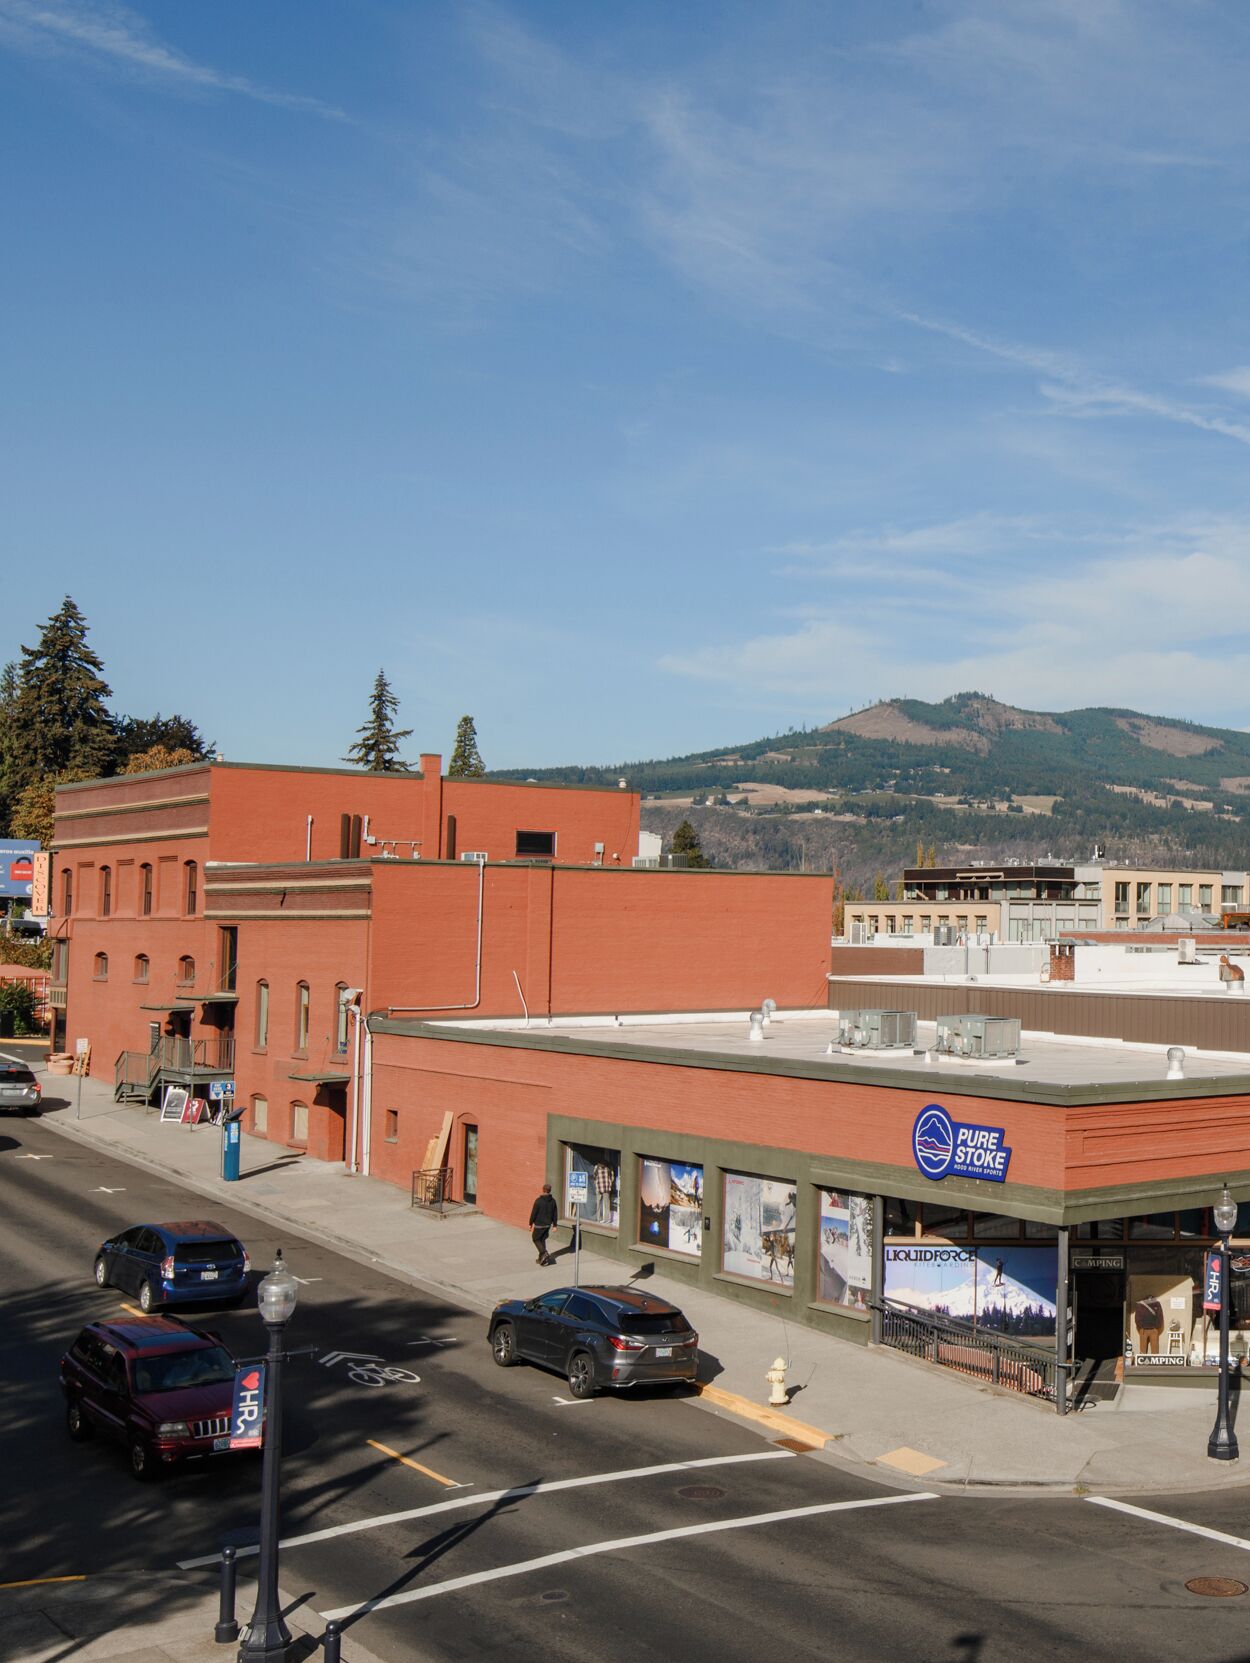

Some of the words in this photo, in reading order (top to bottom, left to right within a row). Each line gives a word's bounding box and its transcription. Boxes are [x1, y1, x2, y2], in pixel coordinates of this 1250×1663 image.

[35, 856, 46, 912] DISCOVER
[957, 1128, 999, 1149] PURE
[954, 1146, 1007, 1170] STOKE
[968, 1165, 982, 1173] RIVER
[983, 1167, 1002, 1176] SPORTS
[1137, 1356, 1184, 1365] CAMPING
